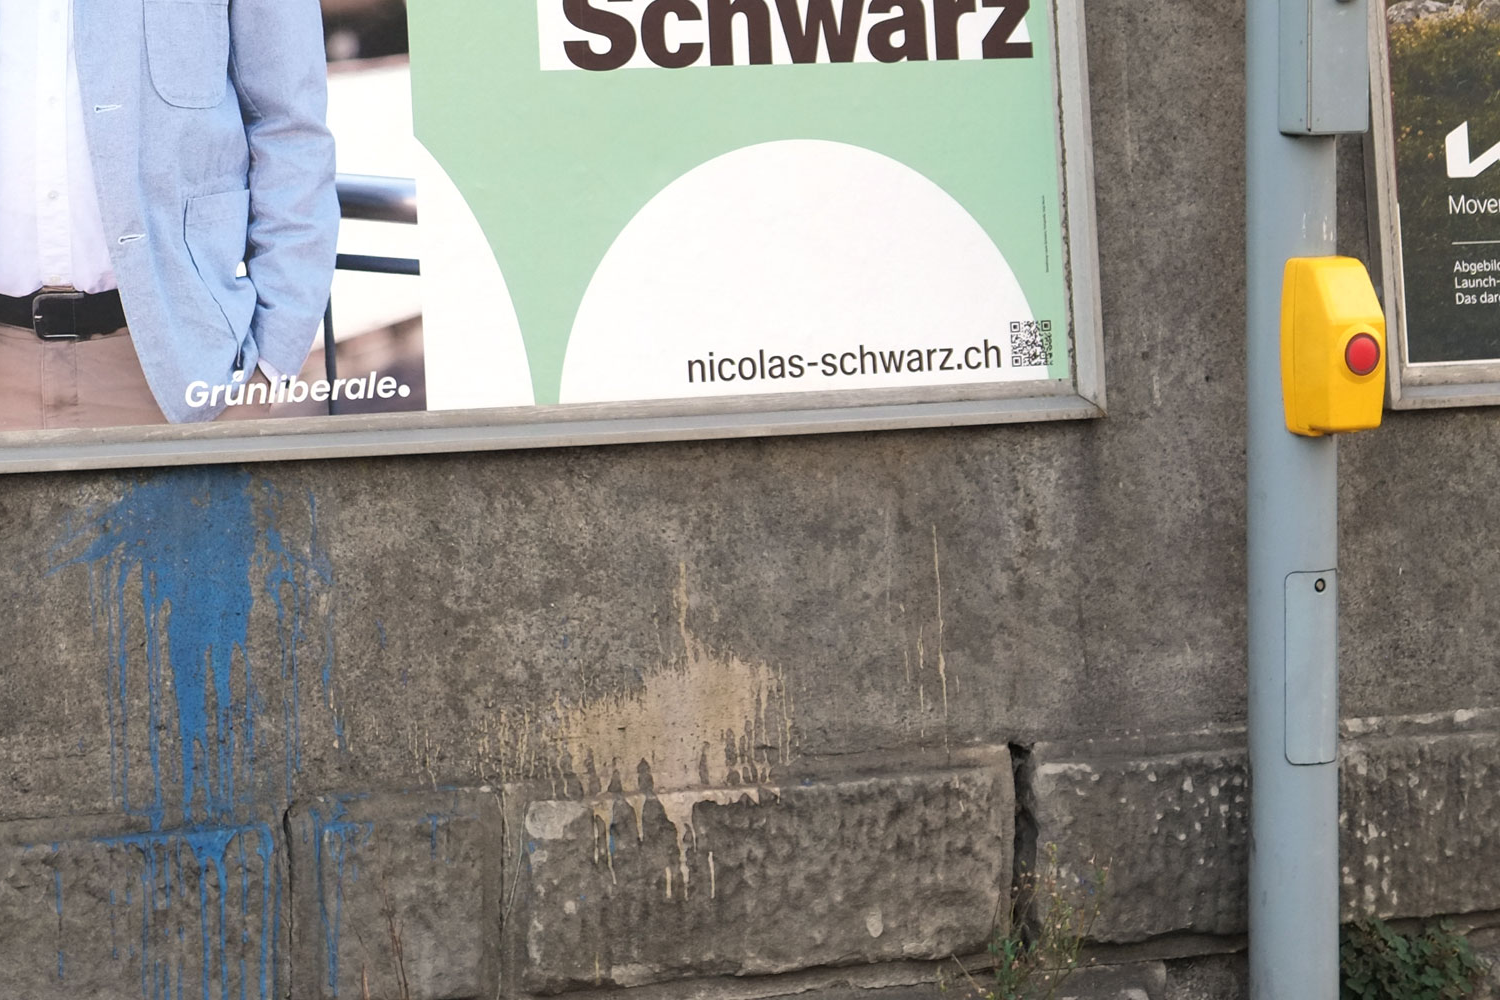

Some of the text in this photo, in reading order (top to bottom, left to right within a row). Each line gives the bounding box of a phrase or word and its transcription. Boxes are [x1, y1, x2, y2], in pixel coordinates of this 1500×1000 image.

[1448, 194, 1500, 215] Move
[1455, 291, 1500, 305] Das dar
[687, 339, 1002, 383] nicolas-schwarz.ch
